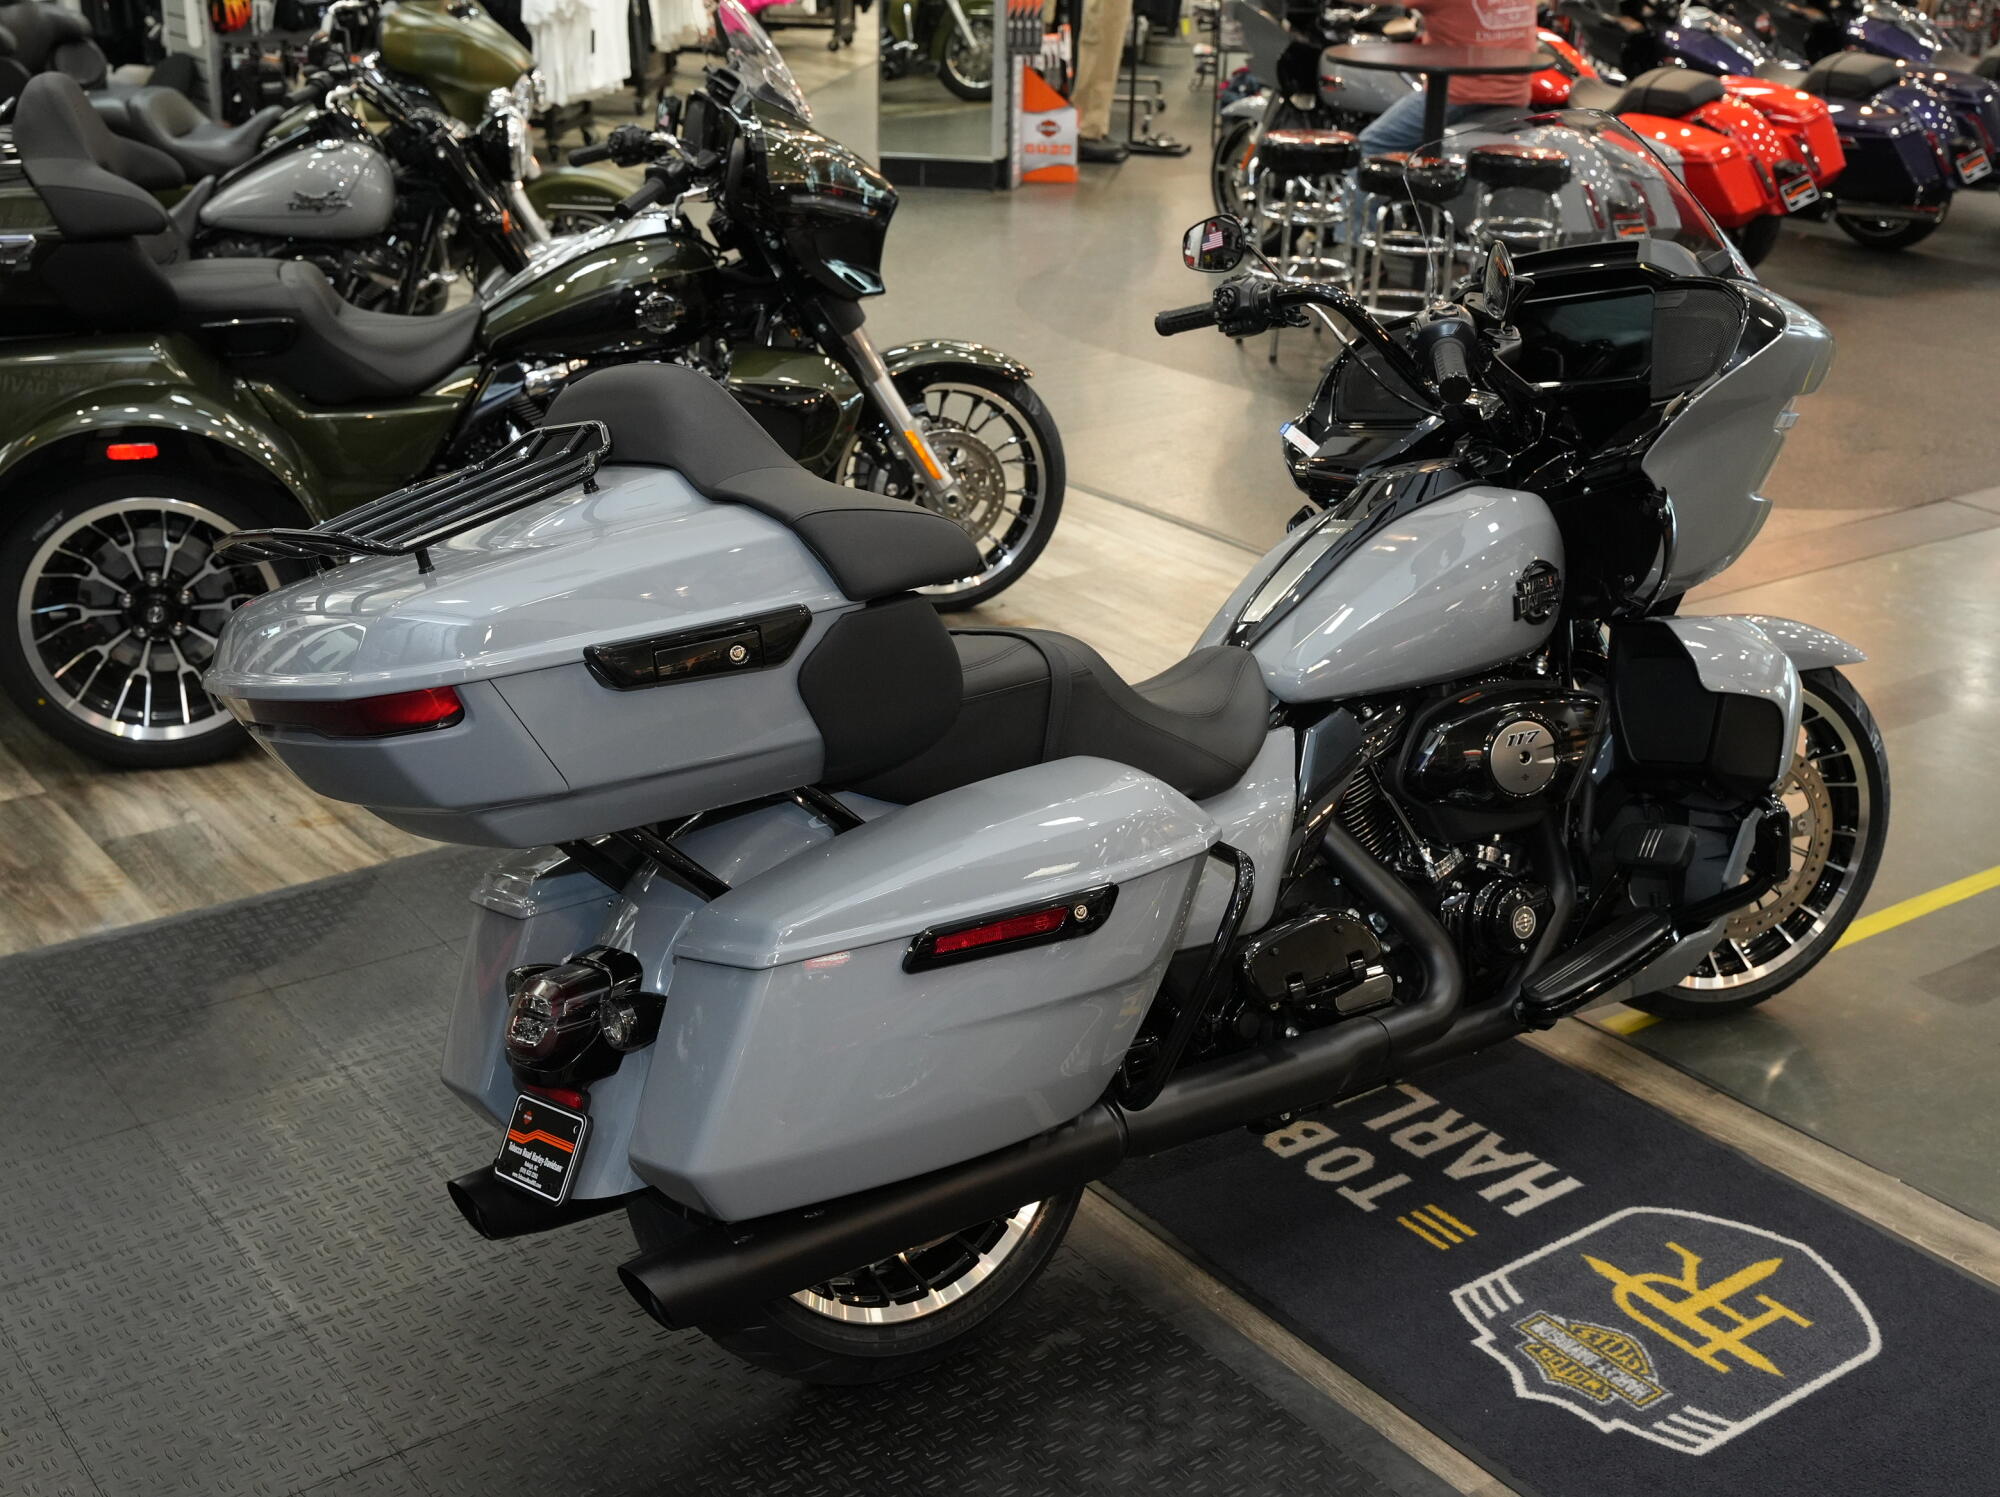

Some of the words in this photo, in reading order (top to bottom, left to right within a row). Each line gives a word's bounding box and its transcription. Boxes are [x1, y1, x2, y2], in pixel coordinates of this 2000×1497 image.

[1506, 729, 1541, 748] 117
[1262, 1120, 1413, 1213] TOB
[1333, 1083, 1585, 1218] HARL
